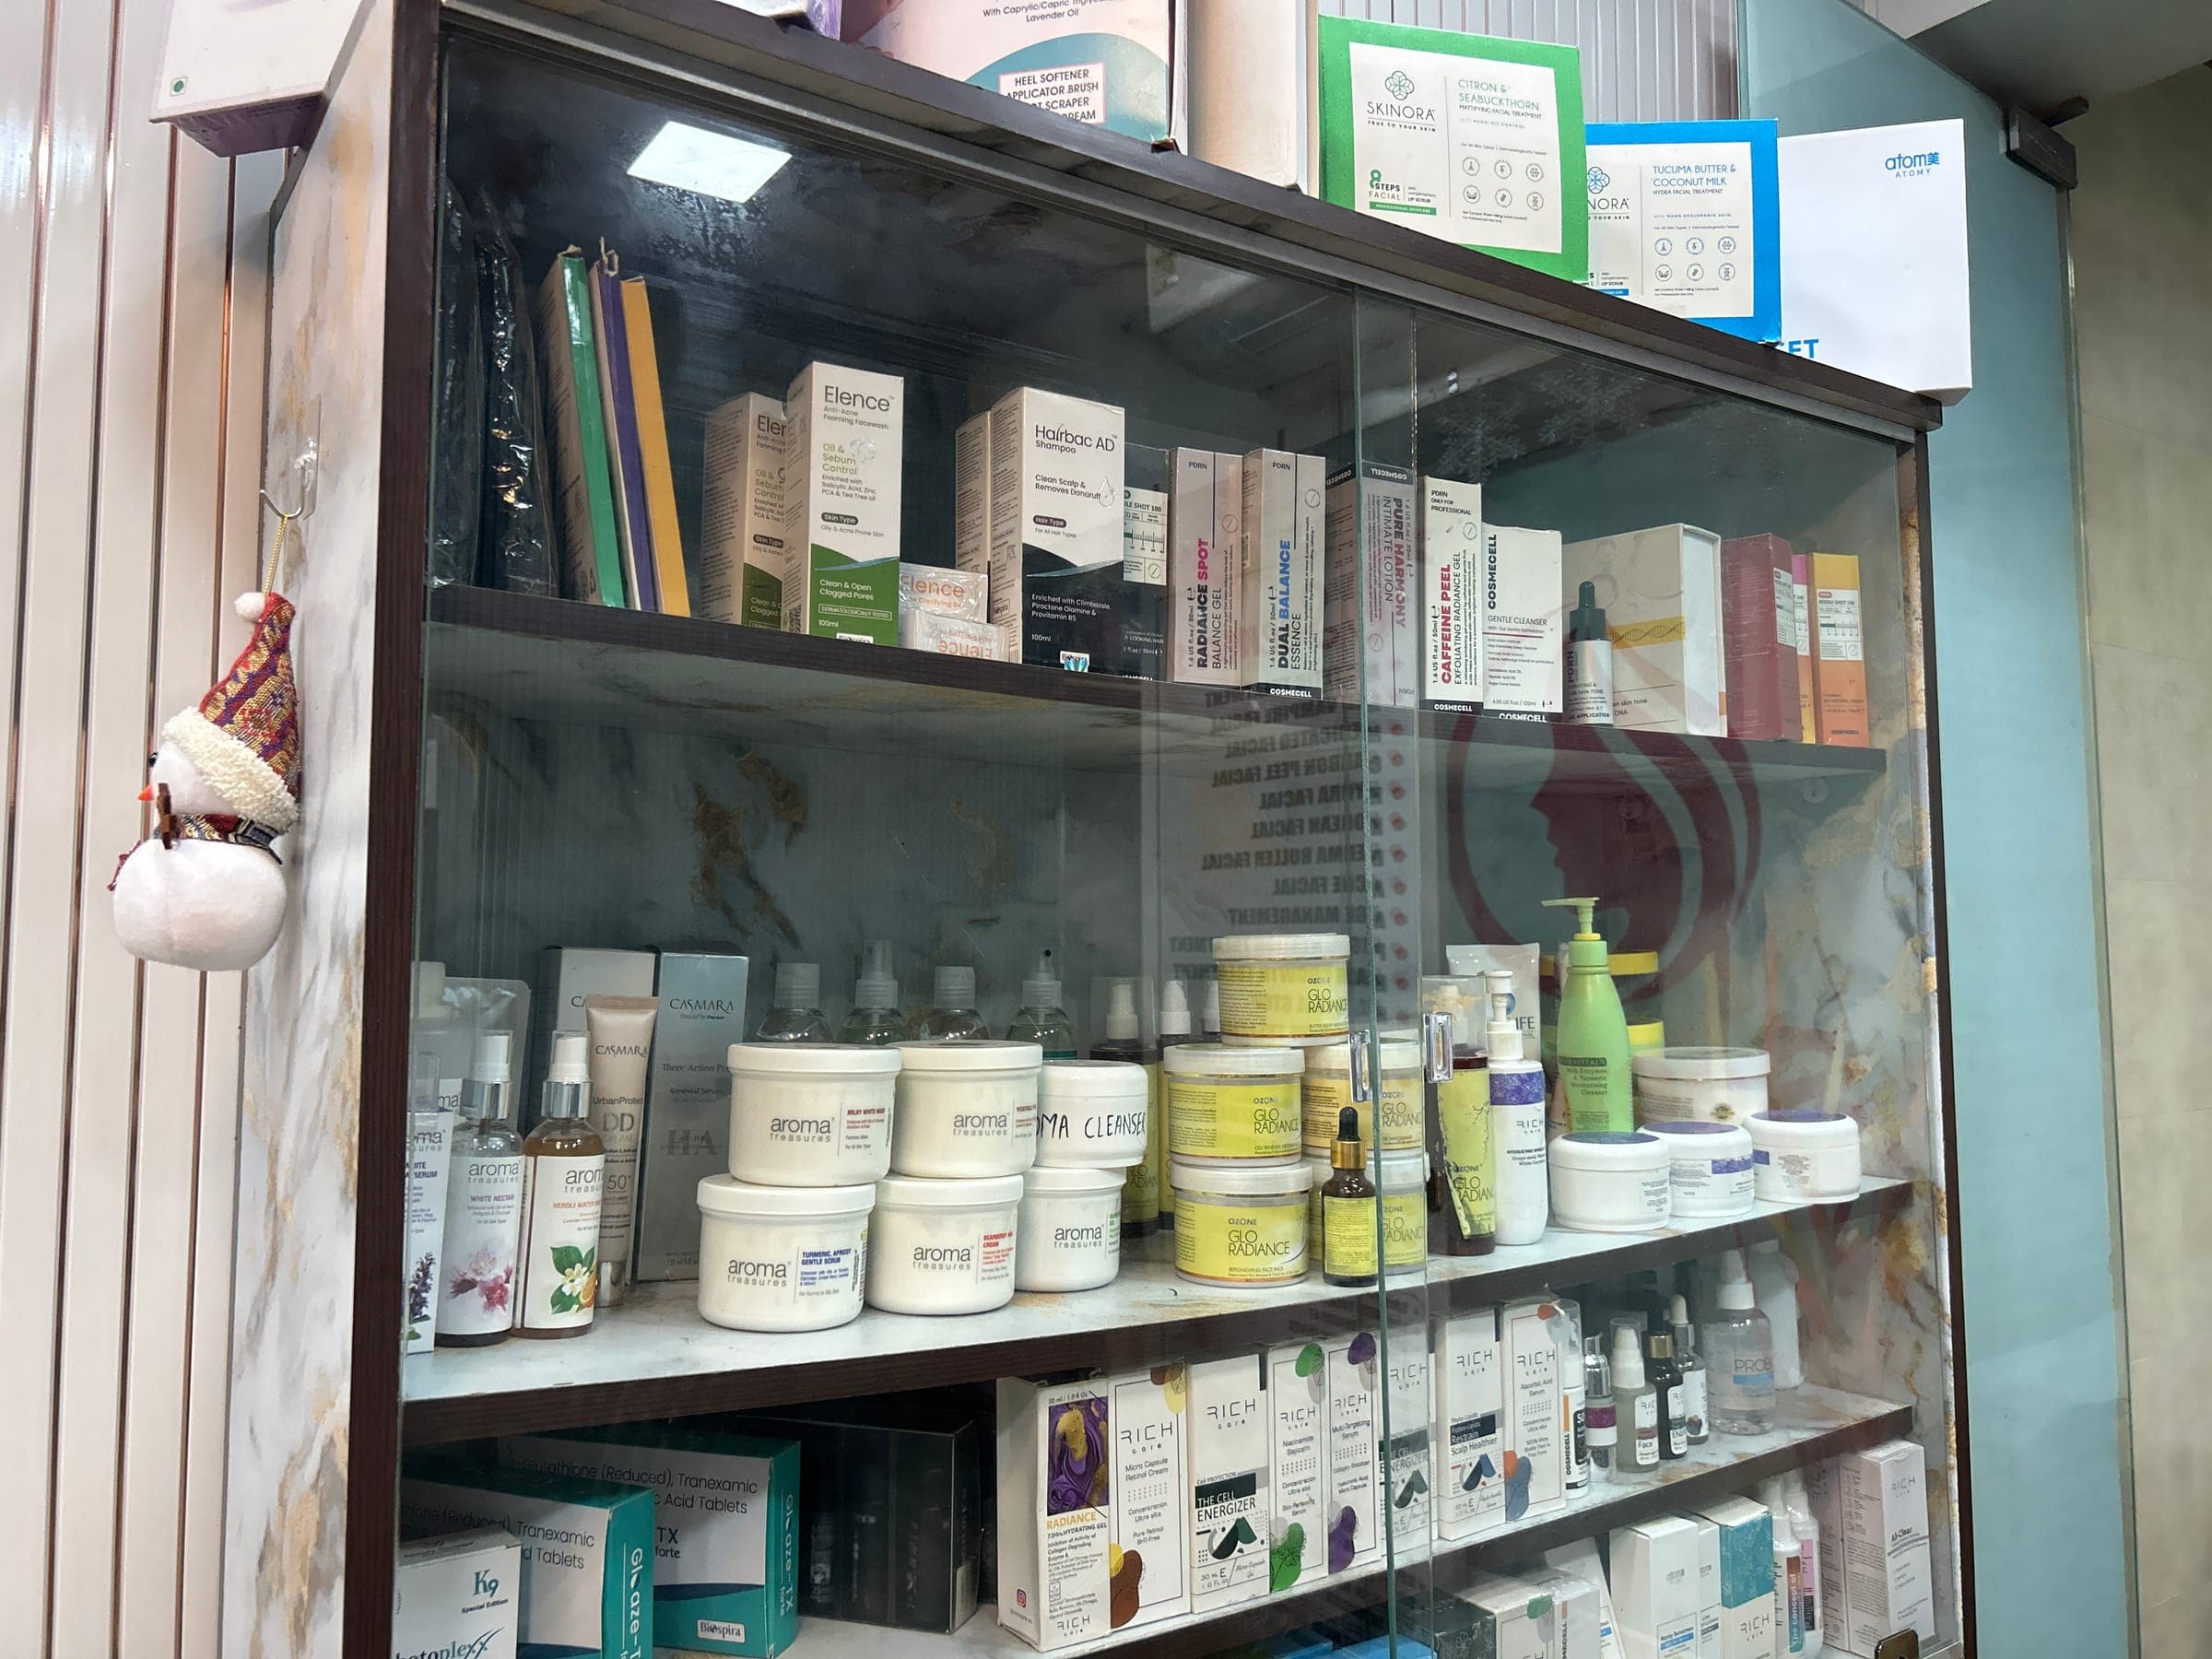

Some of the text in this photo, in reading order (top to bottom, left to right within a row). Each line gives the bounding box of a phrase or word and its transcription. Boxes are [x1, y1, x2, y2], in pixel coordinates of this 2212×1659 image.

[1026, 9, 1079, 23] Lavender Oil
[1015, 69, 1089, 87] HEEL SOFTENER
[1459, 79, 1497, 91] CITRON
[1068, 82, 1099, 94] BRUSH
[1045, 97, 1089, 111] SCRAPER
[1459, 92, 1539, 111] SEABUCKTHORN
[1367, 101, 1435, 122] SKINORA
[1653, 164, 1736, 174] TUCUMA BUTTER &
[1895, 169, 1932, 179] ATOMY
[1374, 183, 1401, 192] STEPS
[1653, 177, 1726, 187] COCONUT MILK
[1369, 191, 1401, 200] FACIAL
[824, 385, 889, 412] Elence
[823, 414, 888, 429] Foaming Facewash
[1035, 423, 1115, 452] Hairbac AD
[822, 443, 845, 453] Oil &
[1035, 440, 1077, 453] Shampoo
[822, 453, 856, 465] Sebum
[1188, 462, 1207, 470] PDRN
[822, 463, 857, 476] Control
[1272, 462, 1290, 471] PDRN
[822, 474, 848, 484] Enriched
[1035, 474, 1057, 484] Clean
[1059, 478, 1079, 488] Scalp
[1035, 483, 1101, 500] Removes Dandruff
[1431, 489, 1448, 498] PDRN
[1431, 505, 1471, 515] PROFESSIONAL
[1051, 518, 1065, 526] Type
[1382, 496, 1394, 602] INTIMATE LOTION
[1394, 497, 1406, 629] PURE HARMONY
[1488, 535, 1497, 609] COSMECELL
[819, 579, 842, 588] Clean
[851, 583, 872, 592] Open
[819, 588, 874, 601] Clogged Pores
[1031, 602, 1063, 612] Piroctone
[1064, 606, 1090, 616] Olamine
[1032, 594, 1061, 604] Enriched
[1077, 599, 1112, 610] Climbazole,
[1197, 538, 1209, 669] RADIANCE SPOT
[1278, 539, 1290, 669] DUAL BALANCE
[1031, 611, 1067, 620] Provitamin
[1488, 615, 1547, 626] GENTLE CLEANSER
[818, 618, 839, 628] 100ml
[1212, 587, 1222, 669] BALANCE GEL
[1441, 564, 1451, 684] CAFFEINE PEEL
[1031, 633, 1052, 642] 100ml
[1291, 613, 1301, 670] ESSENCE
[1269, 688, 1312, 699] COSMECELL
[1434, 703, 1473, 712] COSMECELL
[1307, 989, 1331, 1002] GLO
[670, 998, 735, 1015] CASMARA
[1308, 999, 1347, 1013] RADIANCE
[662, 1063, 715, 1073] Three Action
[669, 1087, 724, 1096] Renewal Serum
[1253, 1109, 1279, 1122] GLO
[1382, 1102, 1406, 1115] GLO
[771, 1117, 830, 1134] aroma
[953, 1112, 1007, 1128] aroma
[1253, 1119, 1299, 1135] RADIANCE
[771, 1134, 831, 1143] treasures
[953, 1127, 1007, 1136] treasures
[468, 1162, 519, 1176] aroma
[1453, 1176, 1481, 1190] GLO
[1054, 1226, 1102, 1241] aroma
[1229, 1230, 1257, 1243] GLO
[1053, 1240, 1102, 1248] treasures
[1229, 1241, 1289, 1256] RADIANCE
[913, 1246, 971, 1262] aroma
[728, 1259, 787, 1278] aroma
[912, 1261, 971, 1270] treasures
[727, 1276, 787, 1288] treasures
[1456, 1349, 1492, 1367] RICH
[1517, 1349, 1555, 1367] RICH
[1335, 1394, 1367, 1409] RICH
[1207, 1399, 1256, 1419] RICH
[1280, 1406, 1316, 1423] RICH
[1218, 1419, 1246, 1430] care
[1121, 1421, 1173, 1443] RICH
[1342, 1430, 1359, 1439] Serum
[1132, 1443, 1162, 1454] care
[1451, 1445, 1468, 1456] Scalp
[1638, 1441, 1653, 1449] Face
[1125, 1456, 1169, 1473] Micro Capsule
[602, 1465, 674, 1488] (Reduced),
[678, 1473, 759, 1495] Tranexamic
[1125, 1467, 1169, 1482] Retinol Cream
[665, 1492, 747, 1514] Acid Tablets
[1197, 1490, 1235, 1508] THE CELL
[1197, 1497, 1256, 1522] ENERGIZER
[1046, 1512, 1097, 1531] RADIANCE
[517, 1523, 594, 1547] Tranexamic
[1133, 1526, 1165, 1539] Pure Retinol
[536, 1548, 584, 1570] Tablets
[655, 1546, 680, 1559] forte
[473, 1570, 500, 1597] K9
[462, 1598, 509, 1614] Special Edition
[1056, 1615, 1090, 1630] RICH
[1740, 1613, 1770, 1632] RICH
[700, 1622, 742, 1638] Biospira
